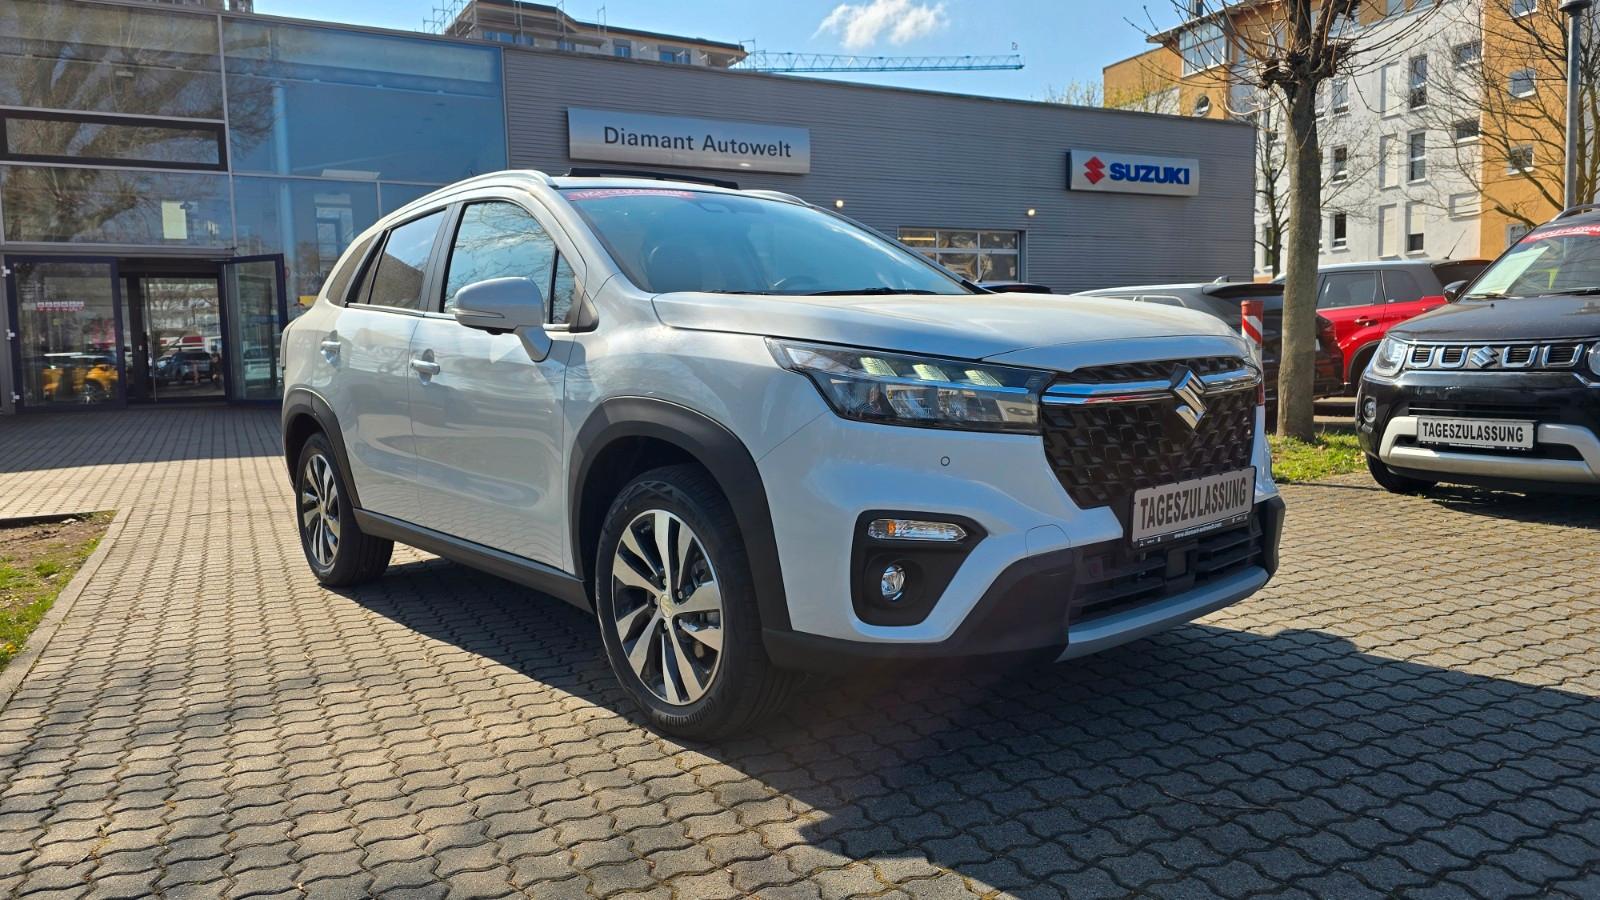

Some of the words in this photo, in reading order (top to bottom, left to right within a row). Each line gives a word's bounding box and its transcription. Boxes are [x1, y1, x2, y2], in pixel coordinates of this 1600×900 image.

[604, 126, 694, 150] Diamant
[702, 135, 792, 158] Autowelt
[1109, 162, 1190, 185] SUZUKI
[1422, 422, 1524, 443] TAGESZULASSUNG
[1140, 477, 1247, 530] TAGESZULASSUNG
